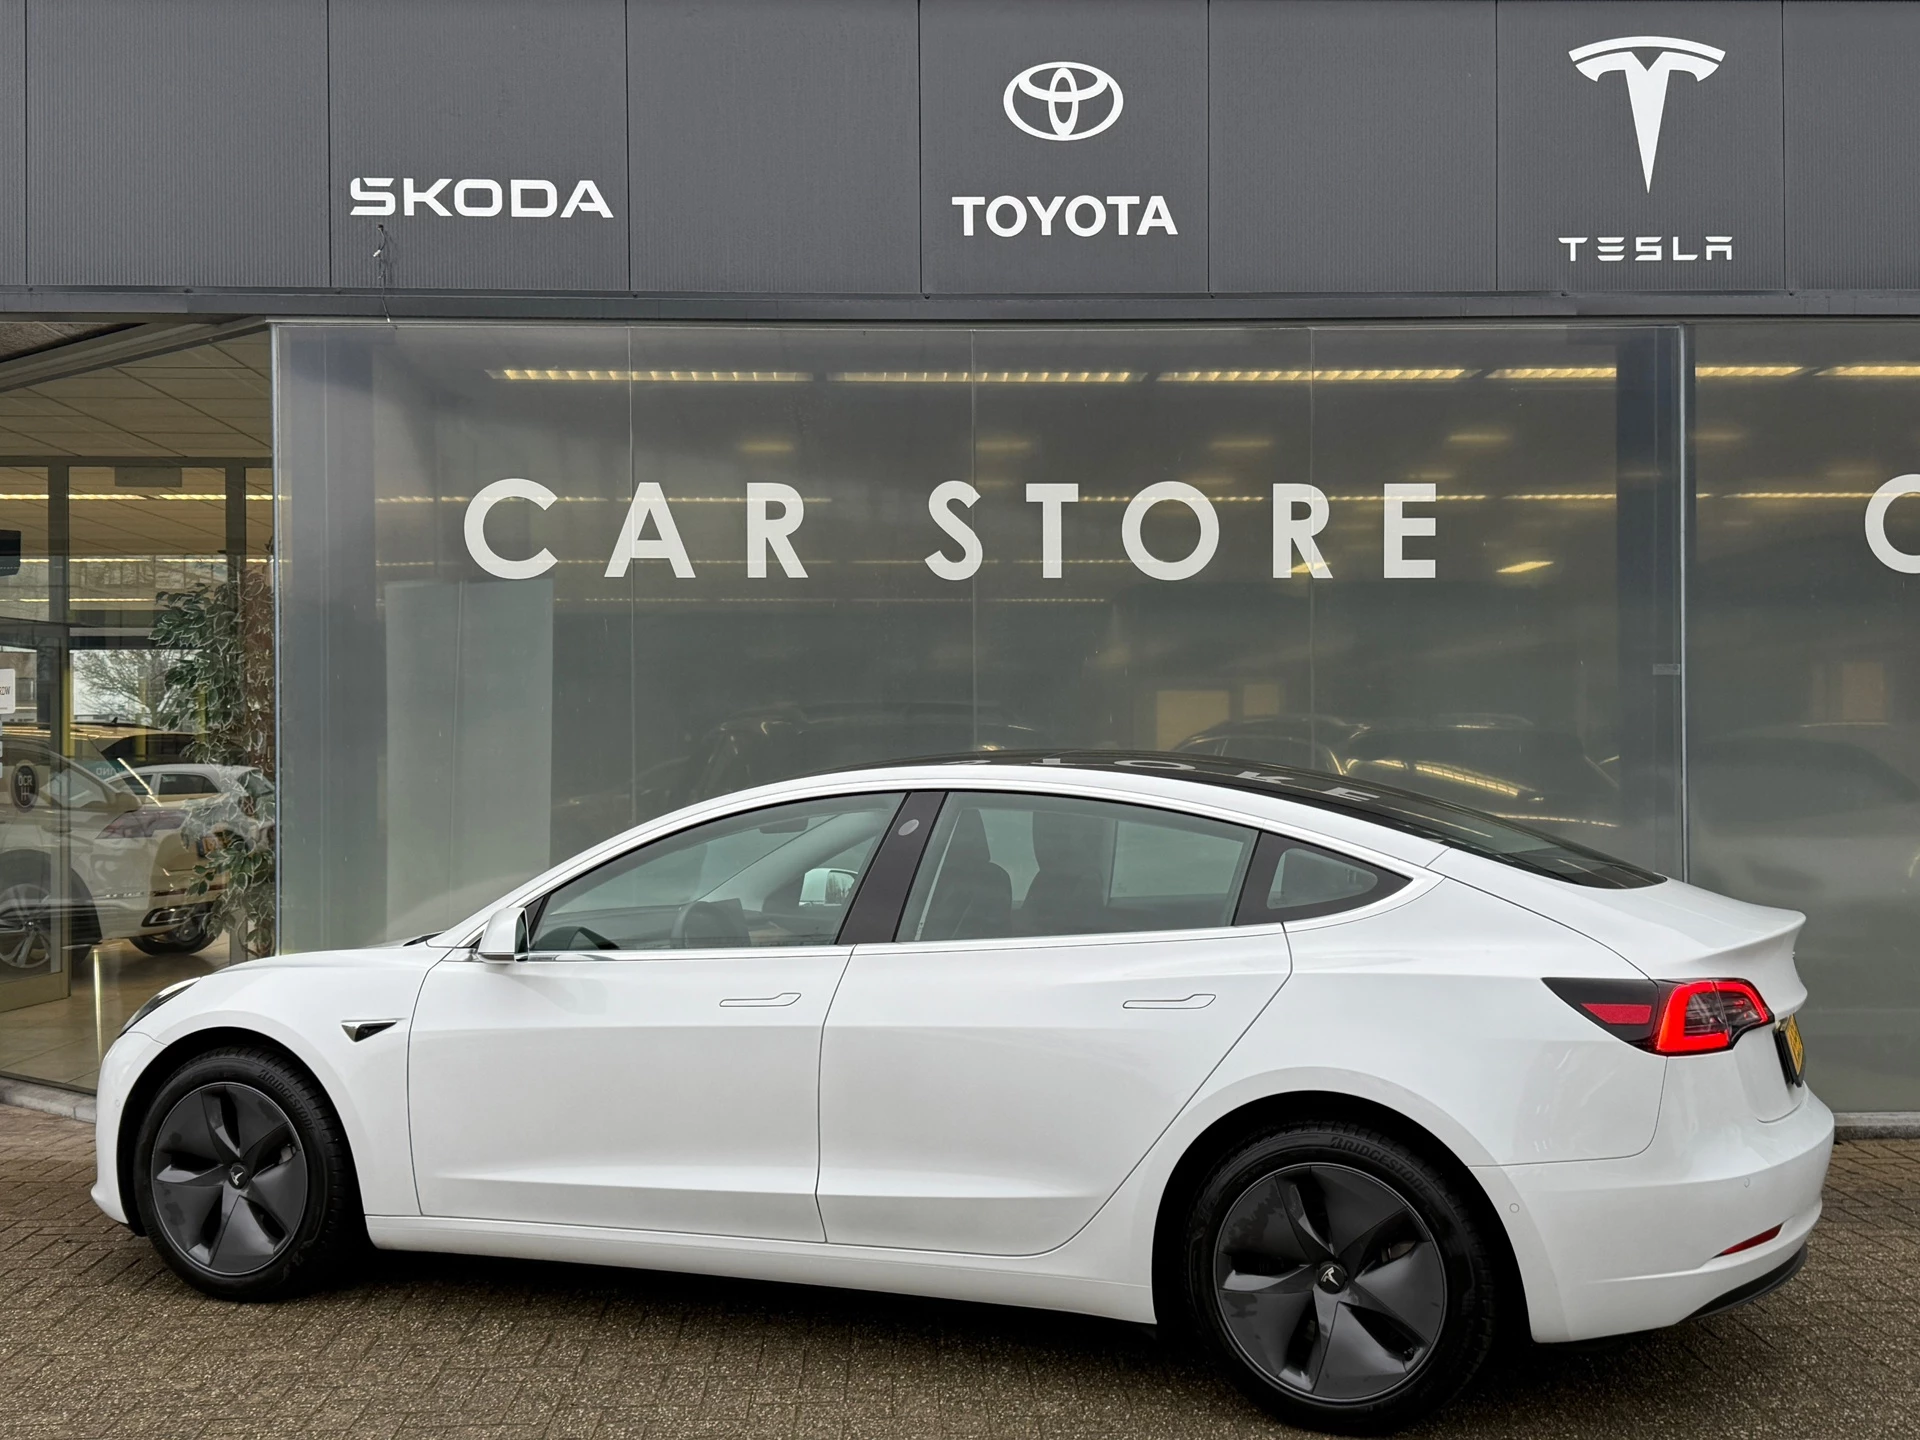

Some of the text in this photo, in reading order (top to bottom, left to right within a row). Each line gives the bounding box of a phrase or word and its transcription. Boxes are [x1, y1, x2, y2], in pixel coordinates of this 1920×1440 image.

[350, 178, 614, 219] SKODA
[952, 195, 1178, 238] TOYOTA
[1558, 235, 1733, 262] TESLA
[463, 479, 1438, 581] CAR STORE
